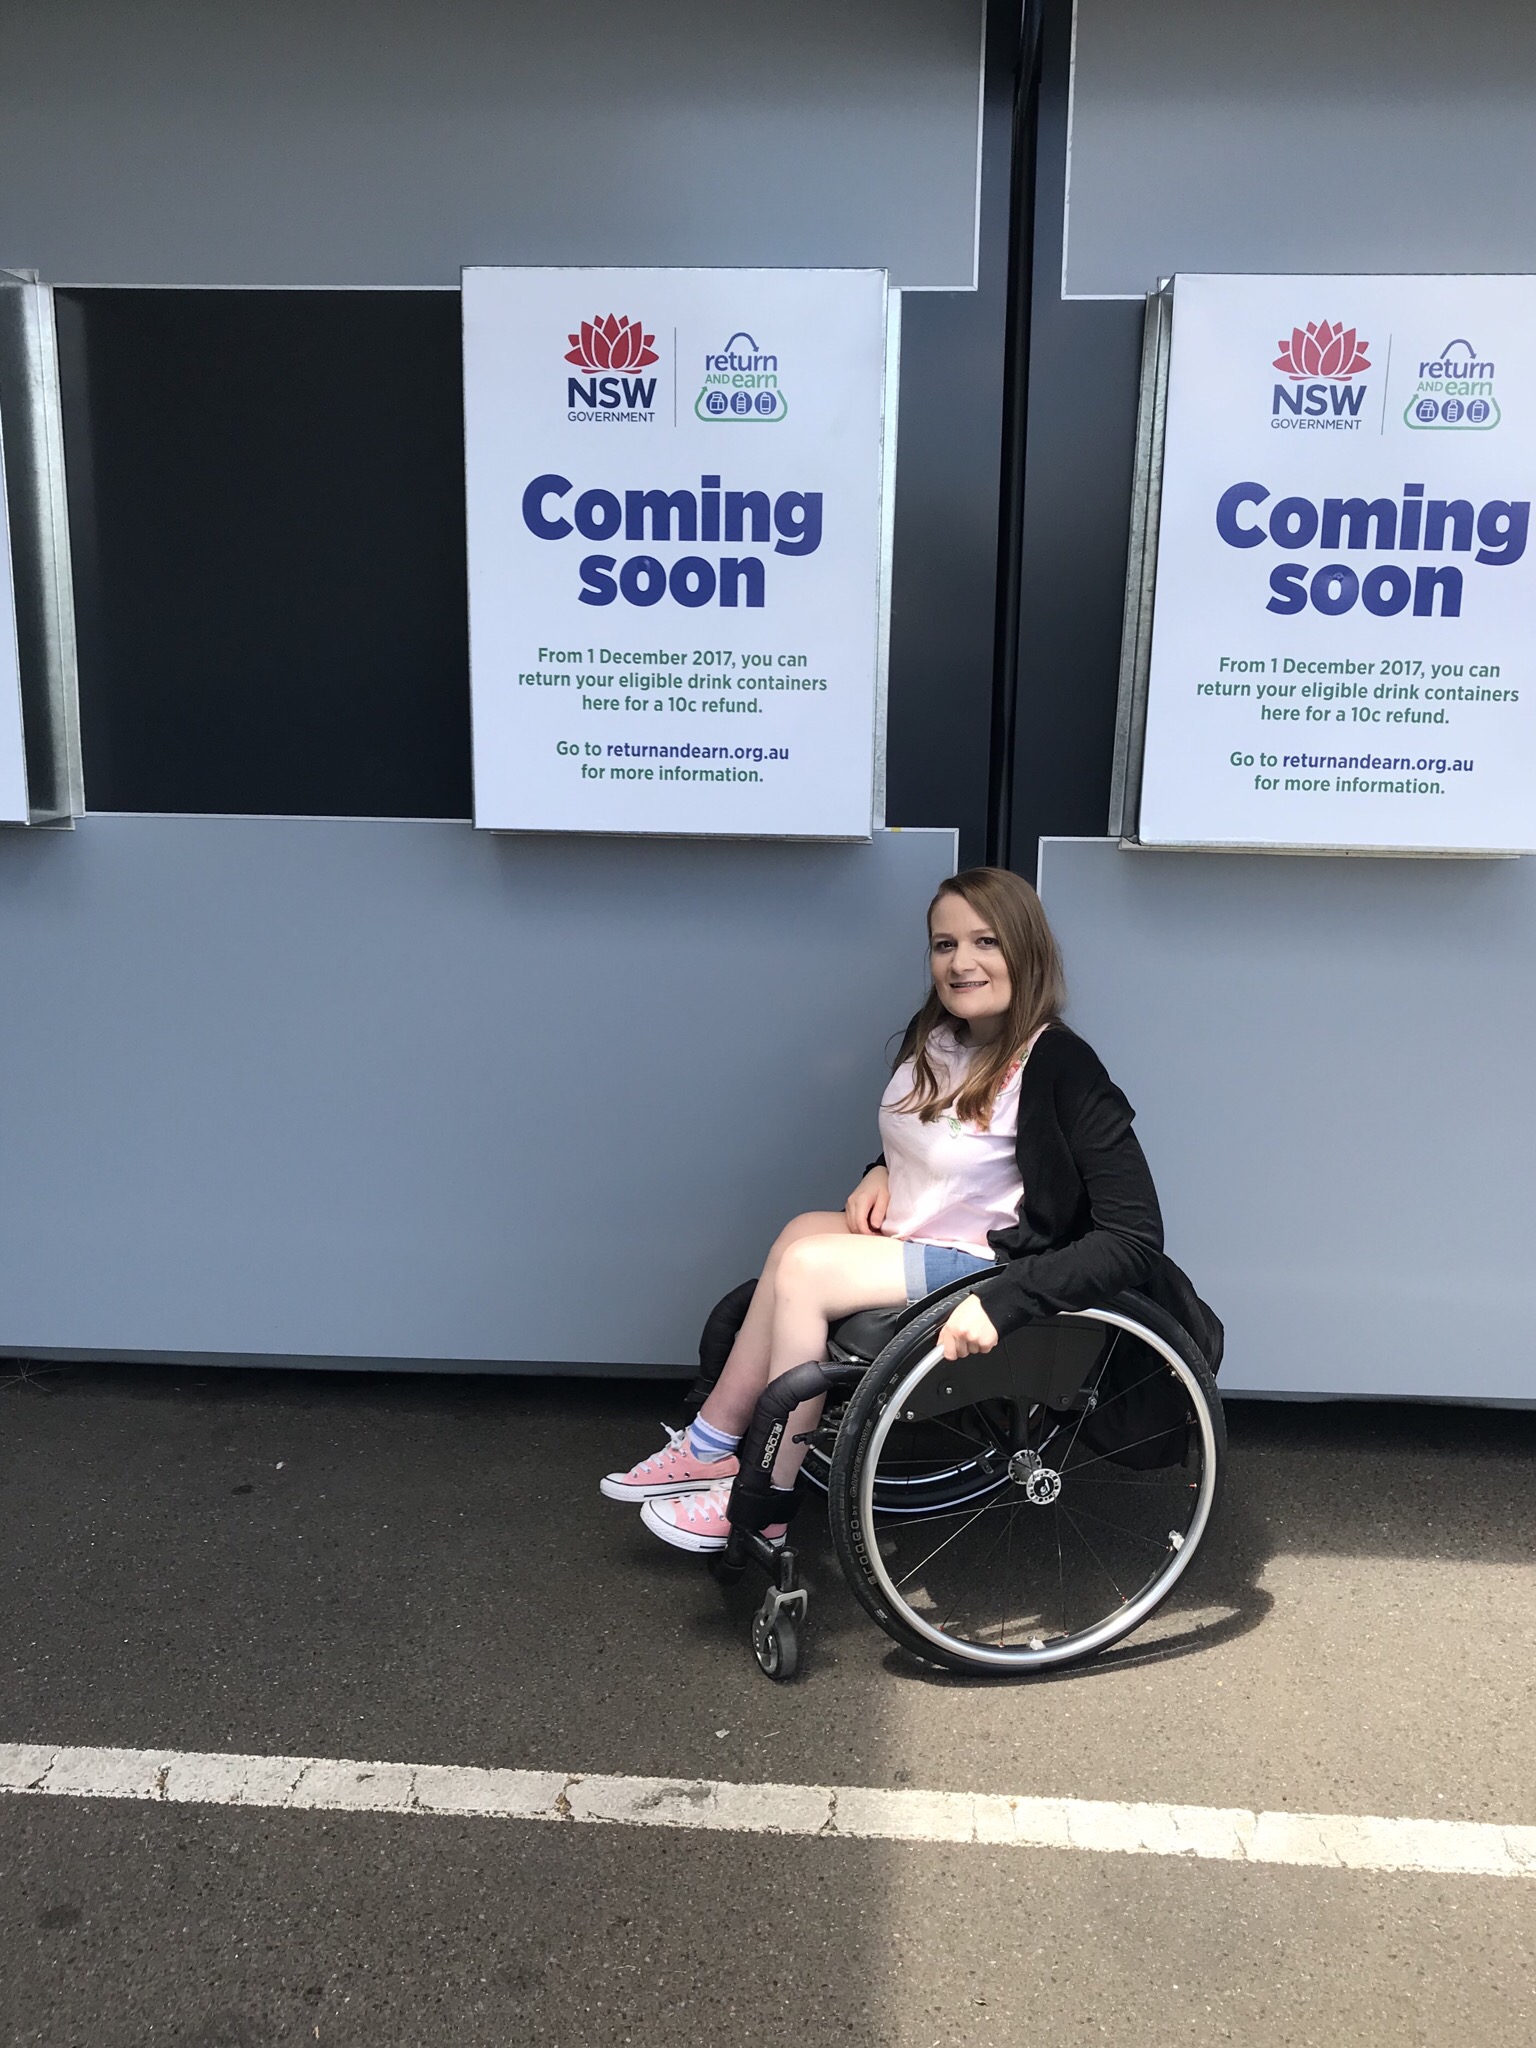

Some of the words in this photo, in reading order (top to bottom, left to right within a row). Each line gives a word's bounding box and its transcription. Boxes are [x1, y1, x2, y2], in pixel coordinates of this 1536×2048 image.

[704, 351, 778, 372] return
[1418, 358, 1495, 380] return
[704, 373, 731, 385] AND
[731, 372, 778, 389] earn
[1416, 380, 1444, 393] AND
[1444, 380, 1493, 397] earn
[567, 376, 658, 410] NSW
[1272, 383, 1368, 417] NSW
[567, 410, 656, 423] GOVERNMENT
[1270, 418, 1363, 431] GOVERNMENT
[521, 473, 824, 557] Coming
[1215, 481, 1531, 567] Coming
[577, 553, 766, 609] soon
[1265, 562, 1464, 618] soon
[538, 647, 583, 664] From
[587, 648, 594, 664] 1
[599, 648, 688, 666] December
[692, 649, 736, 670] 2017,
[740, 654, 773, 670] you
[777, 654, 808, 668] can
[1219, 656, 1266, 674] From
[1270, 657, 1278, 674] 1
[1282, 657, 1376, 676] December
[1379, 659, 1425, 680] 2017,
[1430, 664, 1464, 680] you
[1468, 664, 1501, 678] can
[518, 673, 571, 688] return
[575, 674, 615, 690] your
[618, 672, 683, 692] eligible
[687, 672, 733, 690] drink
[736, 675, 828, 692] containers
[1196, 680, 1251, 698] return
[1256, 684, 1297, 700] your
[1301, 681, 1369, 701] eligible
[1373, 682, 1420, 700] drink
[1424, 685, 1519, 703] containers
[582, 694, 620, 712] here
[624, 695, 650, 712] for
[653, 699, 664, 712] a
[667, 696, 697, 713] 10c
[701, 696, 763, 714] refund.
[1260, 704, 1301, 722] here
[1305, 705, 1332, 722] for
[1335, 709, 1346, 722] a
[1351, 706, 1381, 723] 10c
[1385, 707, 1450, 724] refund.
[556, 740, 580, 757] Go
[584, 741, 603, 758] to
[606, 742, 789, 764] returnandearn.org.au
[1229, 751, 1255, 768] Go
[1259, 752, 1278, 768] to
[1282, 753, 1474, 775] returnandearn.org.au
[580, 763, 606, 781] for
[610, 767, 655, 781] more
[658, 764, 764, 784] information.
[1254, 774, 1280, 791] for
[1284, 778, 1331, 792] more
[1335, 776, 1445, 795] information.
